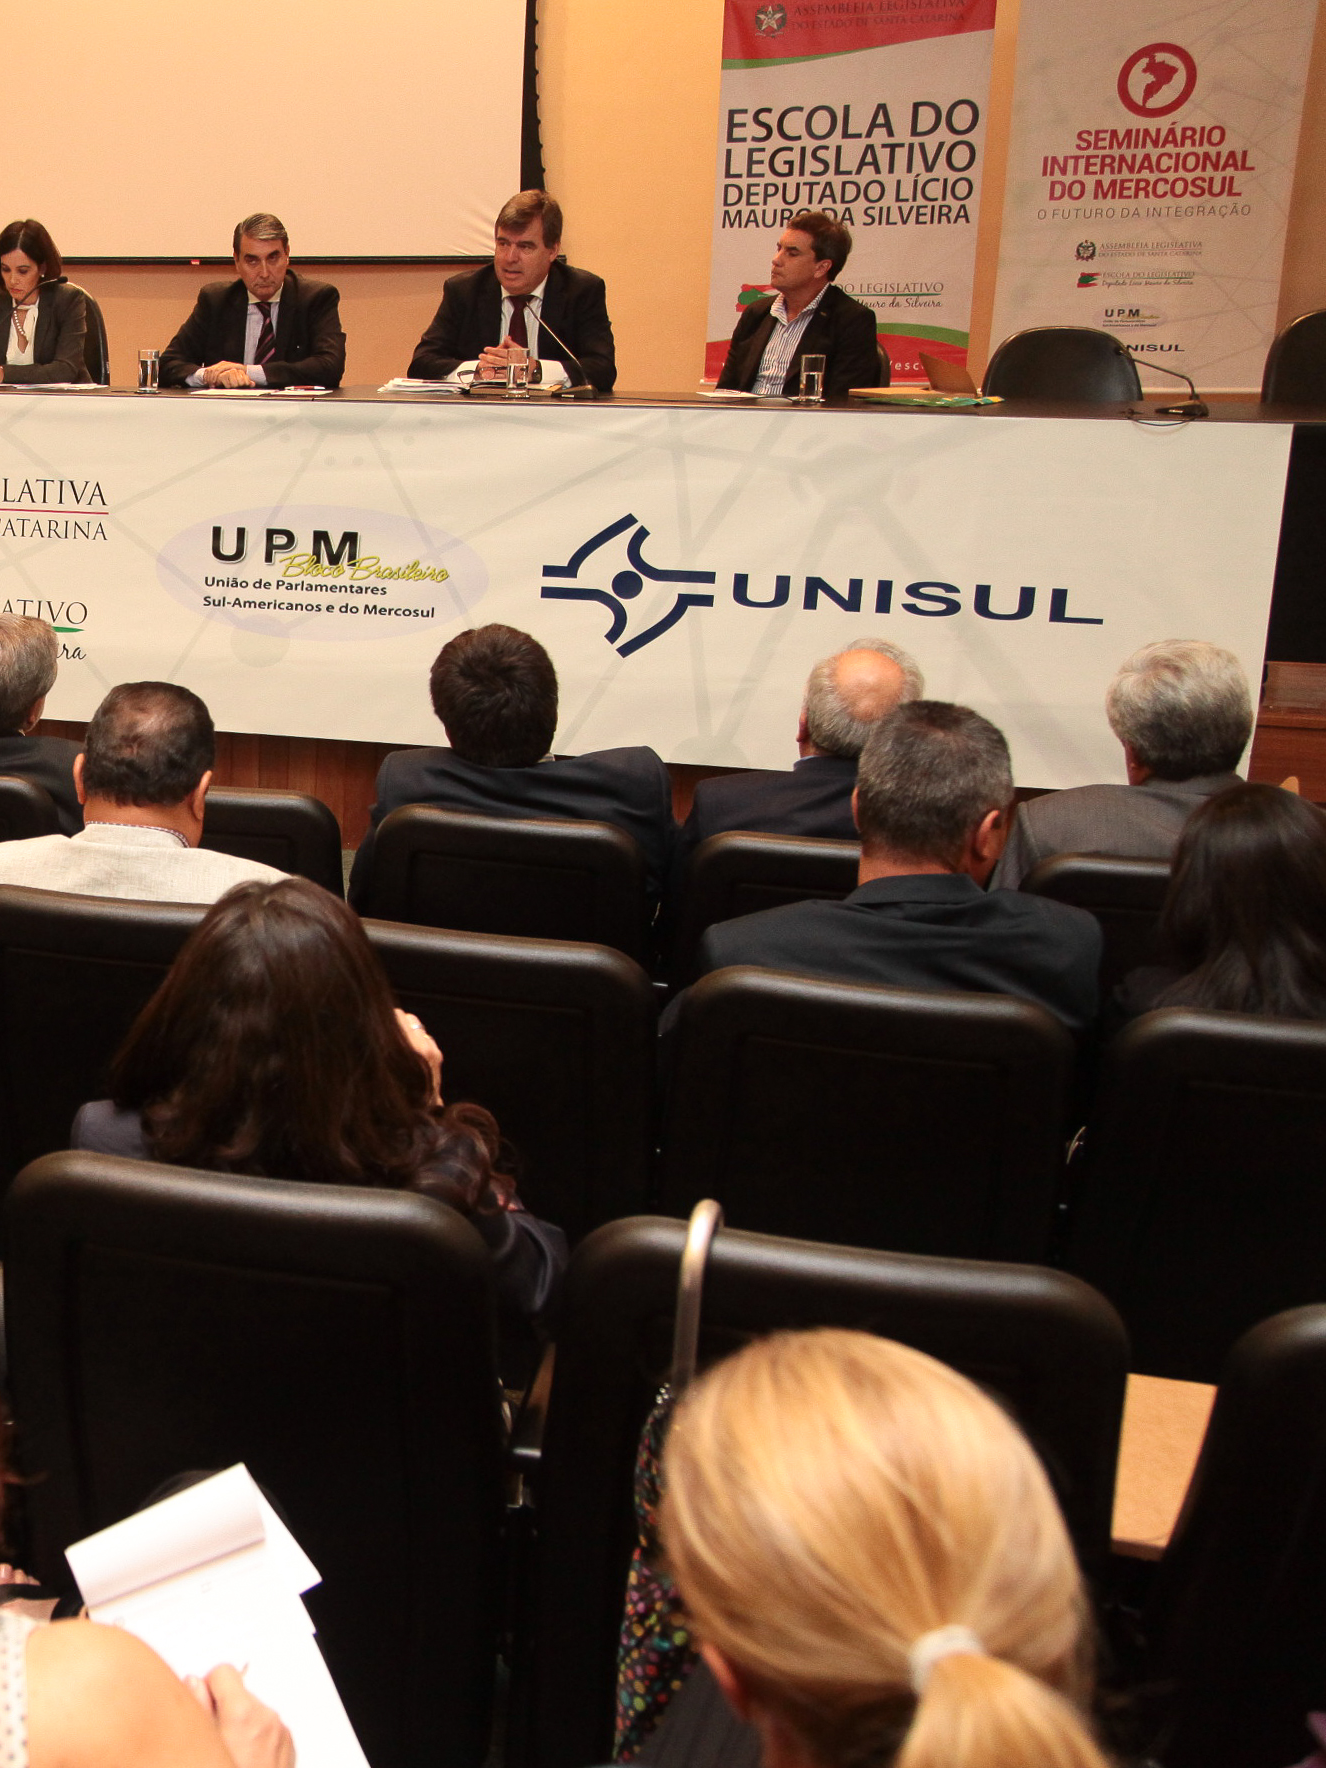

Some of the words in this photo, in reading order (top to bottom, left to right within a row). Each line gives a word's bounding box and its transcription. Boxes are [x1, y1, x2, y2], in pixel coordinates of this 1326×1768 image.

[726, 103, 895, 143] ESCOLA
[910, 99, 980, 138] DO
[1075, 122, 1226, 151] SEMINÁRIO
[724, 140, 976, 179] LEGISLATIVO
[1041, 150, 1256, 177] INTERNACIONAL
[723, 179, 886, 207] DEPUTADO
[894, 173, 974, 203] LÍCIO
[1048, 179, 1086, 201] DO
[1092, 176, 1243, 200] MERCOSUL
[722, 207, 811, 229] MAUR
[862, 204, 971, 227] SILVEIRA
[1037, 208, 1047, 220] O
[1052, 207, 1116, 219] FUTURO
[1120, 206, 1141, 218] DA
[1146, 203, 1252, 219] INTEGRAÇÃO
[859, 282, 944, 293] LEGISLATIVO
[888, 297, 901, 307] da
[903, 296, 942, 308] Silveira
[1126, 344, 1185, 352] NISUL
[211, 525, 360, 567] UPM
[278, 552, 346, 578] Bloco
[347, 555, 450, 583] Brasileiro
[204, 576, 249, 589] União
[253, 578, 272, 590] de
[276, 579, 387, 596] Parlamentares
[732, 572, 1104, 625] UNISUL
[203, 596, 322, 613] Sul-Americanos
[325, 604, 335, 613] e
[338, 602, 360, 615] do
[363, 603, 435, 618] Mercosul
